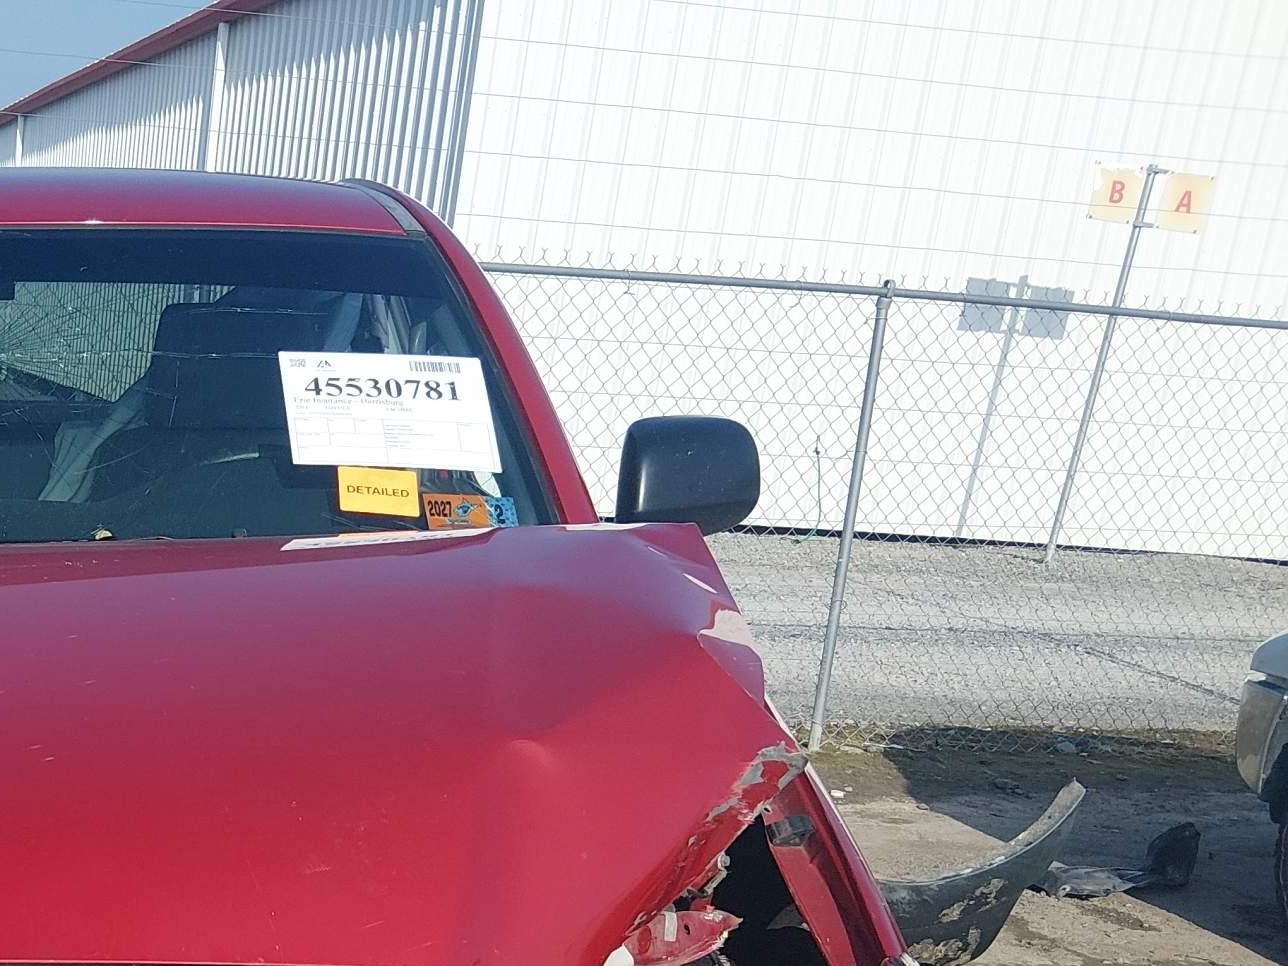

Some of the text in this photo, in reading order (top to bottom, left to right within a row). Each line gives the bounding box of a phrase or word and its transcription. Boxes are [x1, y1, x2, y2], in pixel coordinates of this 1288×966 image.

[1108, 180, 1125, 204] B
[1175, 190, 1192, 214] A
[305, 377, 460, 400] 45530781
[346, 485, 410, 498] DETAILED
[427, 500, 452, 518] 2027
